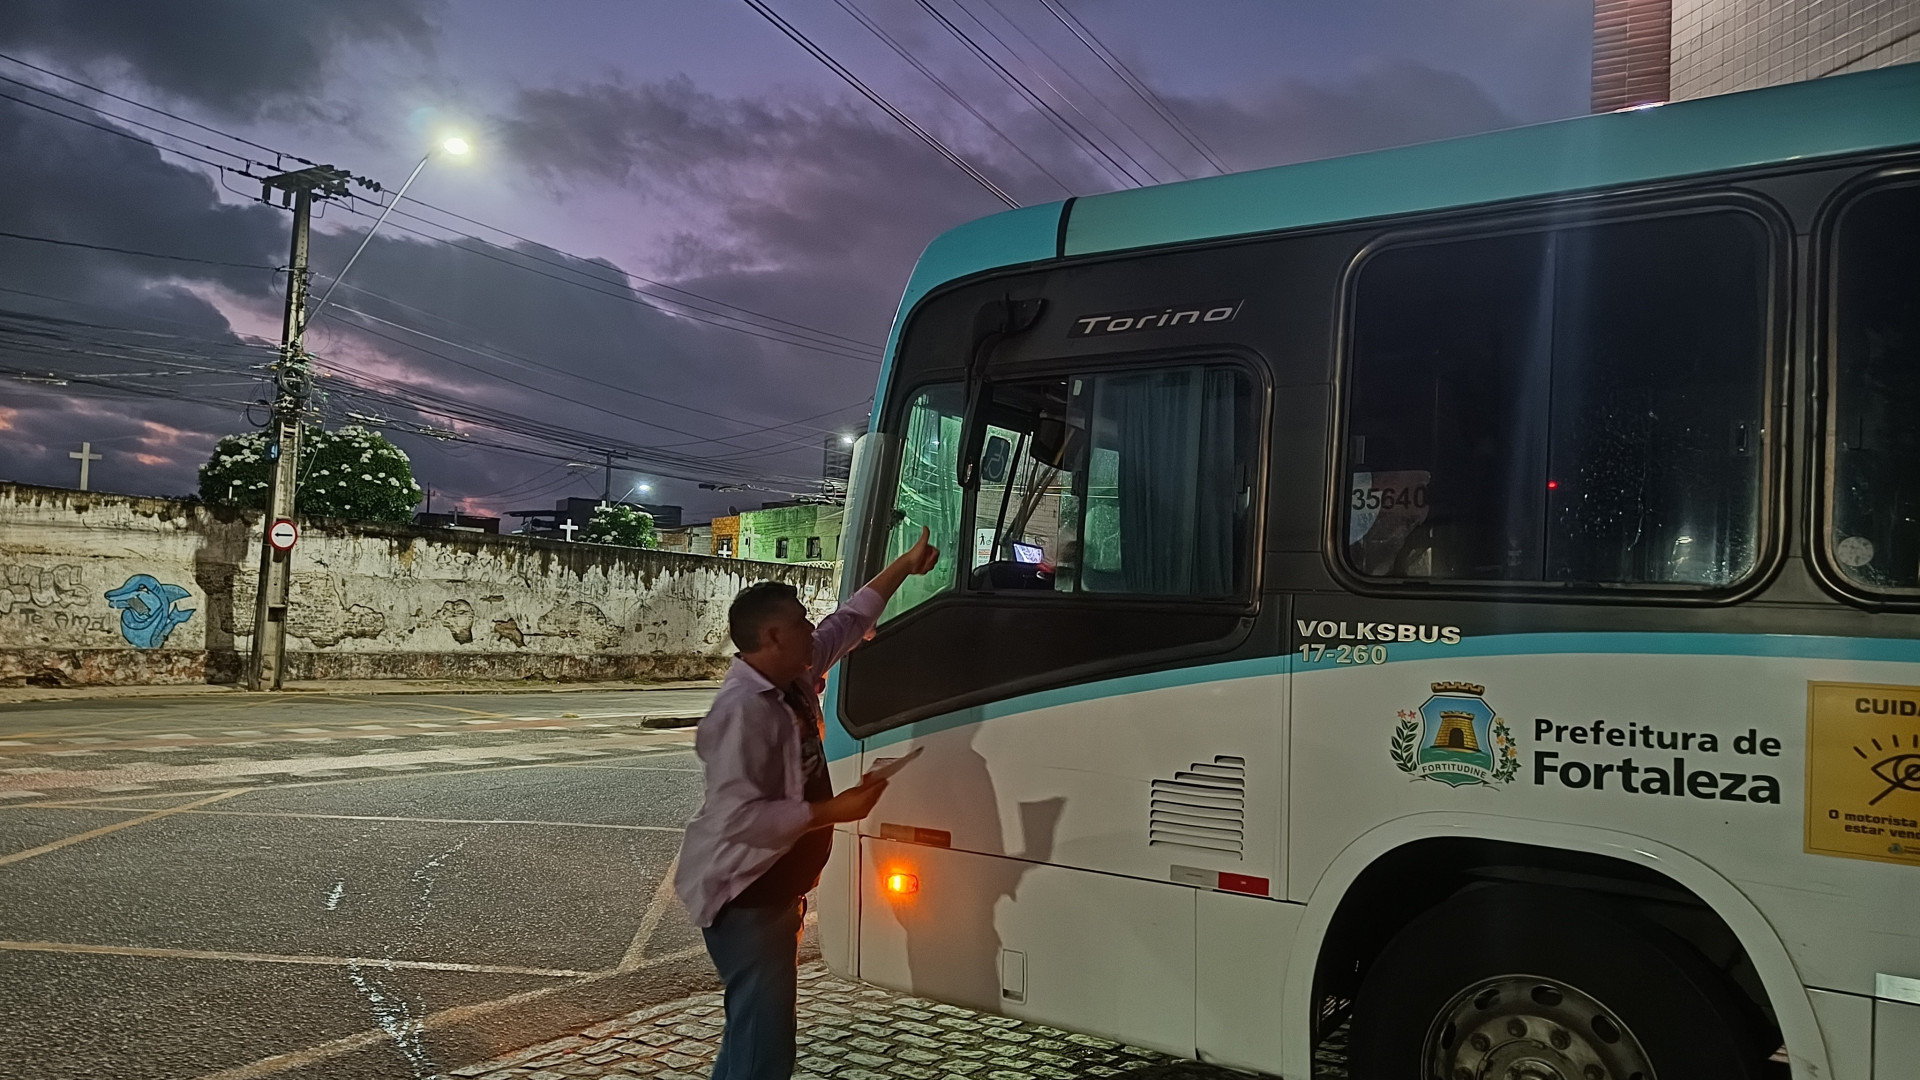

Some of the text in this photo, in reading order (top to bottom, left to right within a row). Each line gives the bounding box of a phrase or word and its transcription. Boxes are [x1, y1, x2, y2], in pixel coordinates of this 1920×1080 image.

[1078, 307, 1233, 334] Torino
[1352, 485, 1427, 510] 35640
[1296, 619, 1462, 645] VOLKSBUS
[1299, 643, 1388, 666] 17-260
[1855, 697, 1920, 717] CUID
[1534, 718, 1782, 757] Prefeitura de
[1421, 763, 1487, 779] FORTITUDINE
[1533, 750, 1781, 805] Fortaleza
[1828, 809, 1918, 828] O motorista
[1844, 824, 1885, 836] estar
